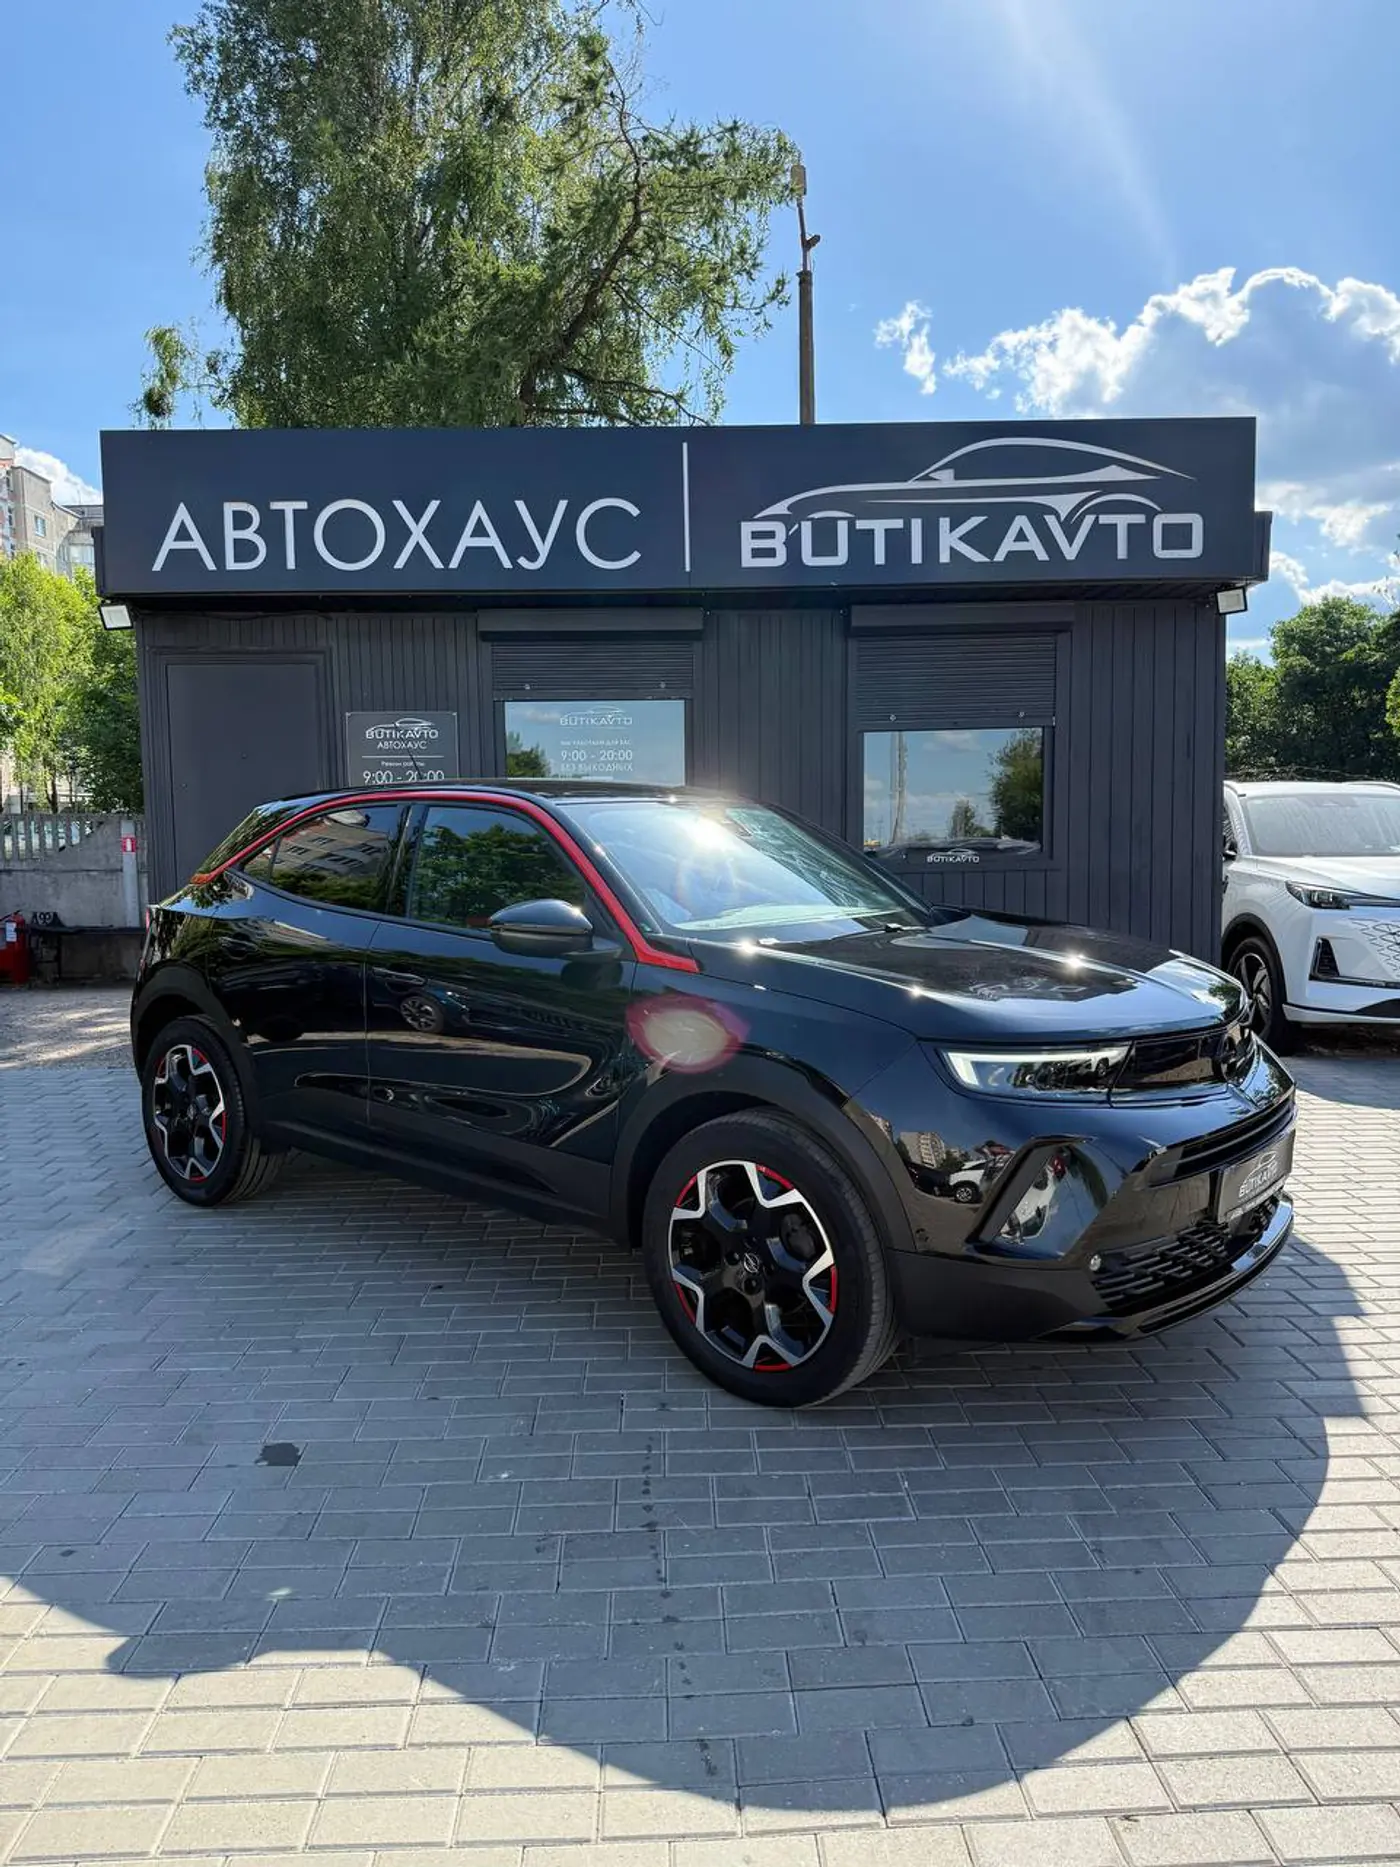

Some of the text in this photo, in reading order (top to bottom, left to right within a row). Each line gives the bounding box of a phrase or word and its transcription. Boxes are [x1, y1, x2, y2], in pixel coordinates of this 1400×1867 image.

[152, 498, 642, 572] АВТОХАУС
[740, 512, 1204, 568] BUTIKAVTO
[559, 716, 633, 726] BUTIKAVTO
[365, 729, 439, 739] BUTIKAVTO
[376, 741, 428, 750] АВТОХАУС
[561, 750, 586, 761] 9:00
[600, 750, 633, 761] 20:00
[363, 770, 394, 784] 9:00
[926, 854, 980, 863] BUTIKAVTO
